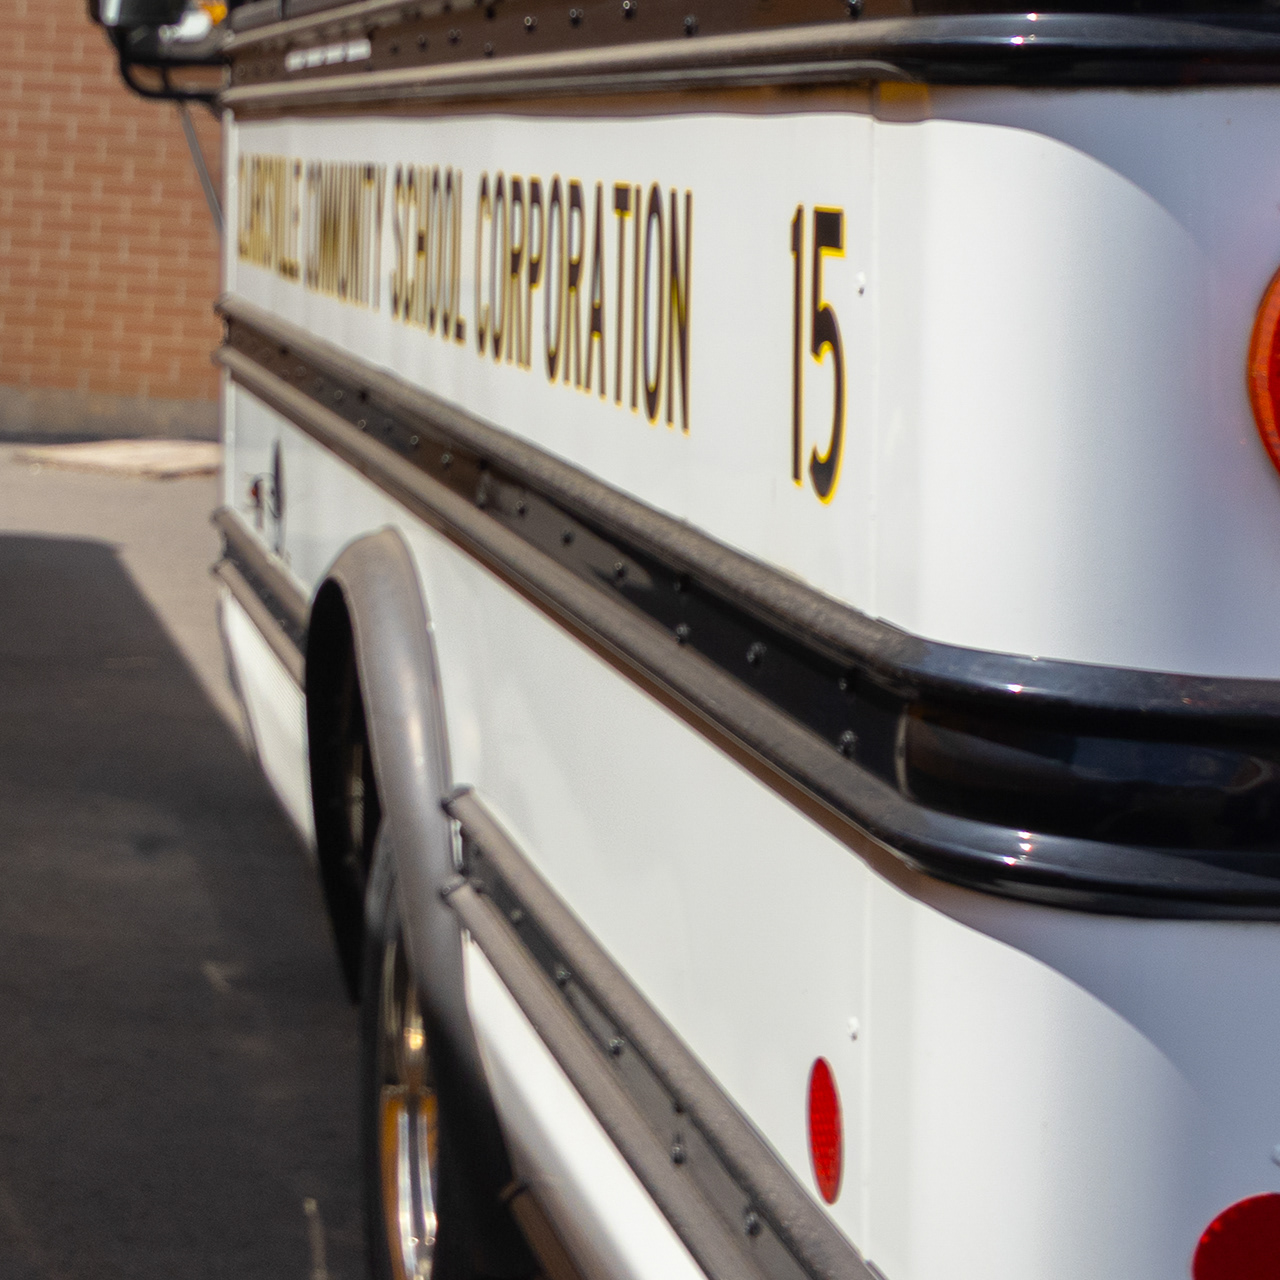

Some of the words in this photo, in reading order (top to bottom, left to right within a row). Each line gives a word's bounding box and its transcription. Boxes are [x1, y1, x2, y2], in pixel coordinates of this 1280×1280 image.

[390, 160, 467, 346] SCHOOL
[474, 169, 694, 436] CORPORATION
[789, 201, 847, 505] 15
